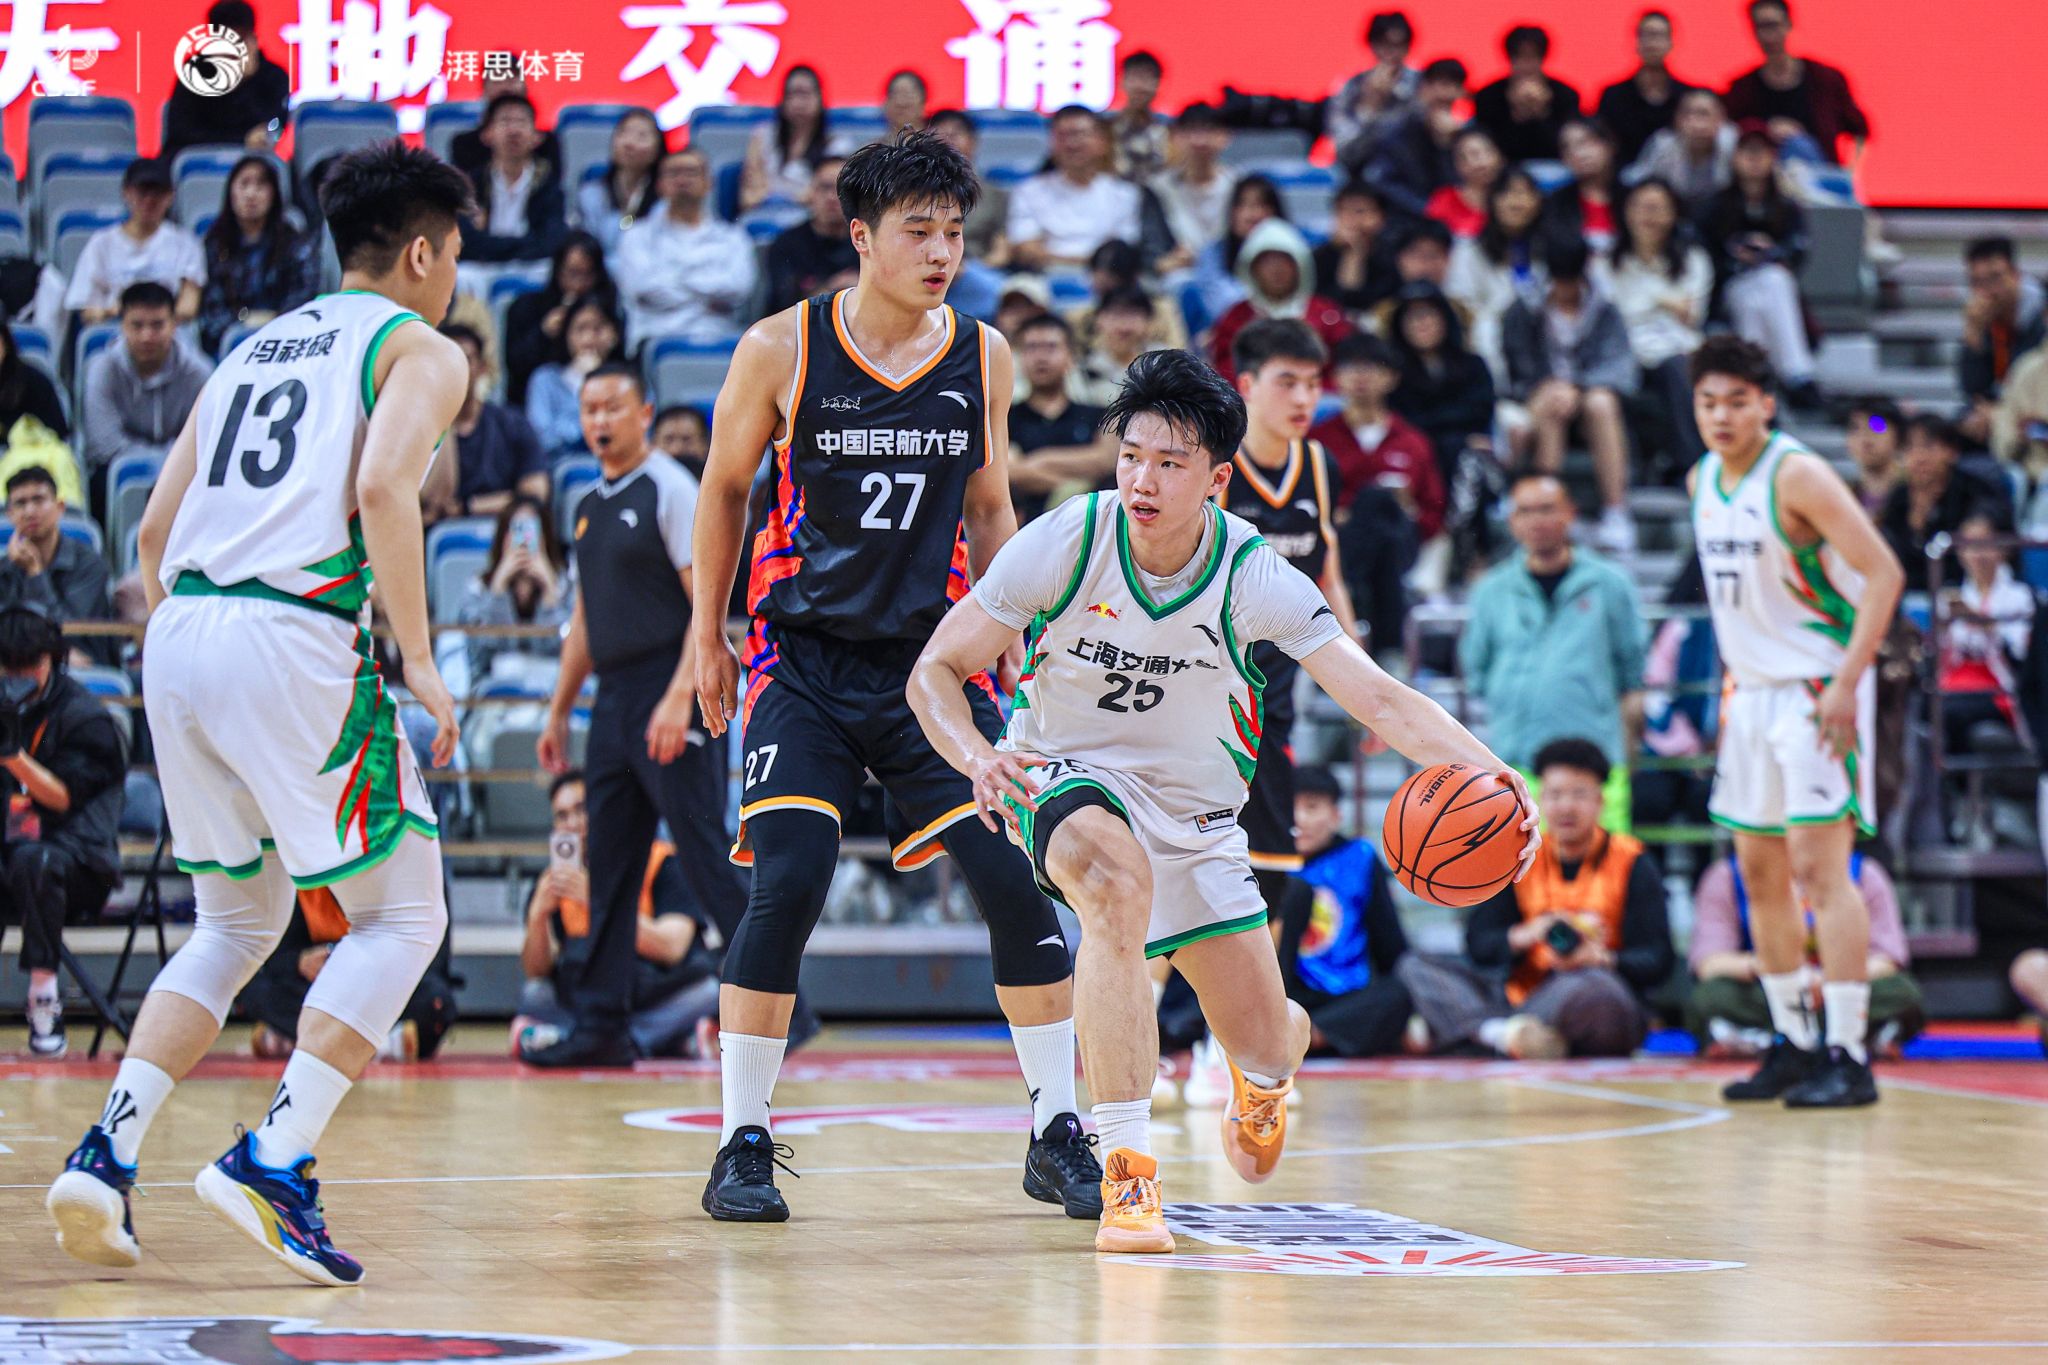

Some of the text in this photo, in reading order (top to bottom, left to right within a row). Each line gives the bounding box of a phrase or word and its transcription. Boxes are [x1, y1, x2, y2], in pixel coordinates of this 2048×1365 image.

[244, 328, 342, 365] 冯祥硕
[207, 378, 308, 489] 13
[815, 428, 970, 456] 中国民航大学
[860, 471, 927, 531] 27
[1097, 672, 1165, 713] 25
[745, 743, 779, 792] 27
[1041, 758, 1089, 781] 25
[1419, 769, 1455, 807] CUBAL
